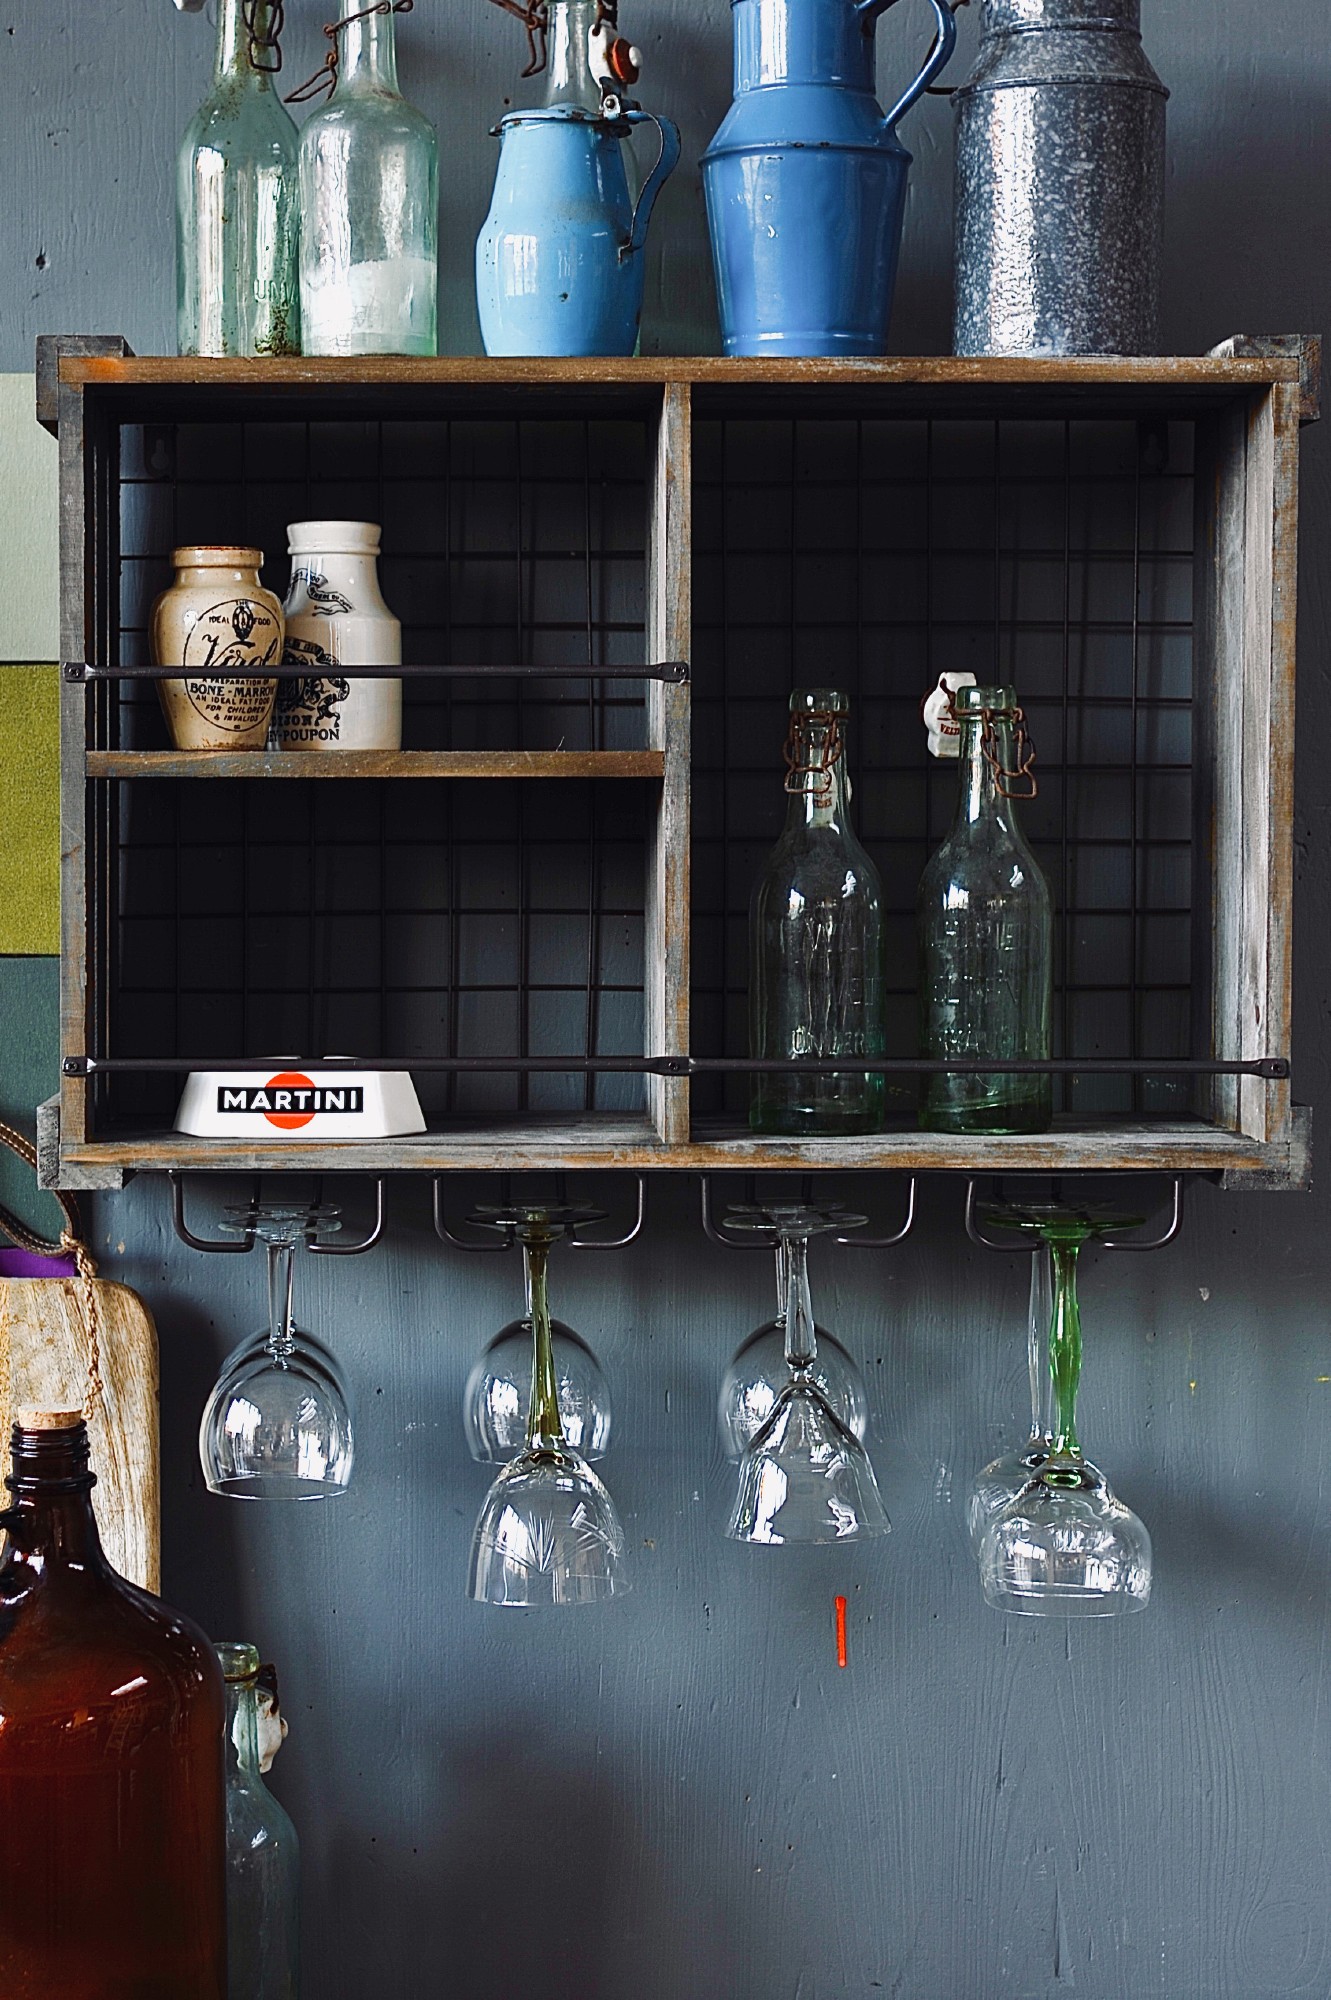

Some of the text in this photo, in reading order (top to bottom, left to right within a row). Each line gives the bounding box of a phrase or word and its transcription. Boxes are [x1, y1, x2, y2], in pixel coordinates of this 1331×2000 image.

[209, 615, 271, 626] IDEAL FOOD
[210, 678, 261, 686] PREPARATION
[190, 682, 225, 696] BONE
[195, 694, 207, 702] AN
[211, 697, 236, 705] IDEAL
[227, 706, 266, 714] CHILDREN
[224, 714, 259, 722] INVALIDS
[267, 729, 339, 742] EY-POUPON
[223, 1090, 357, 1110] MARTINI
